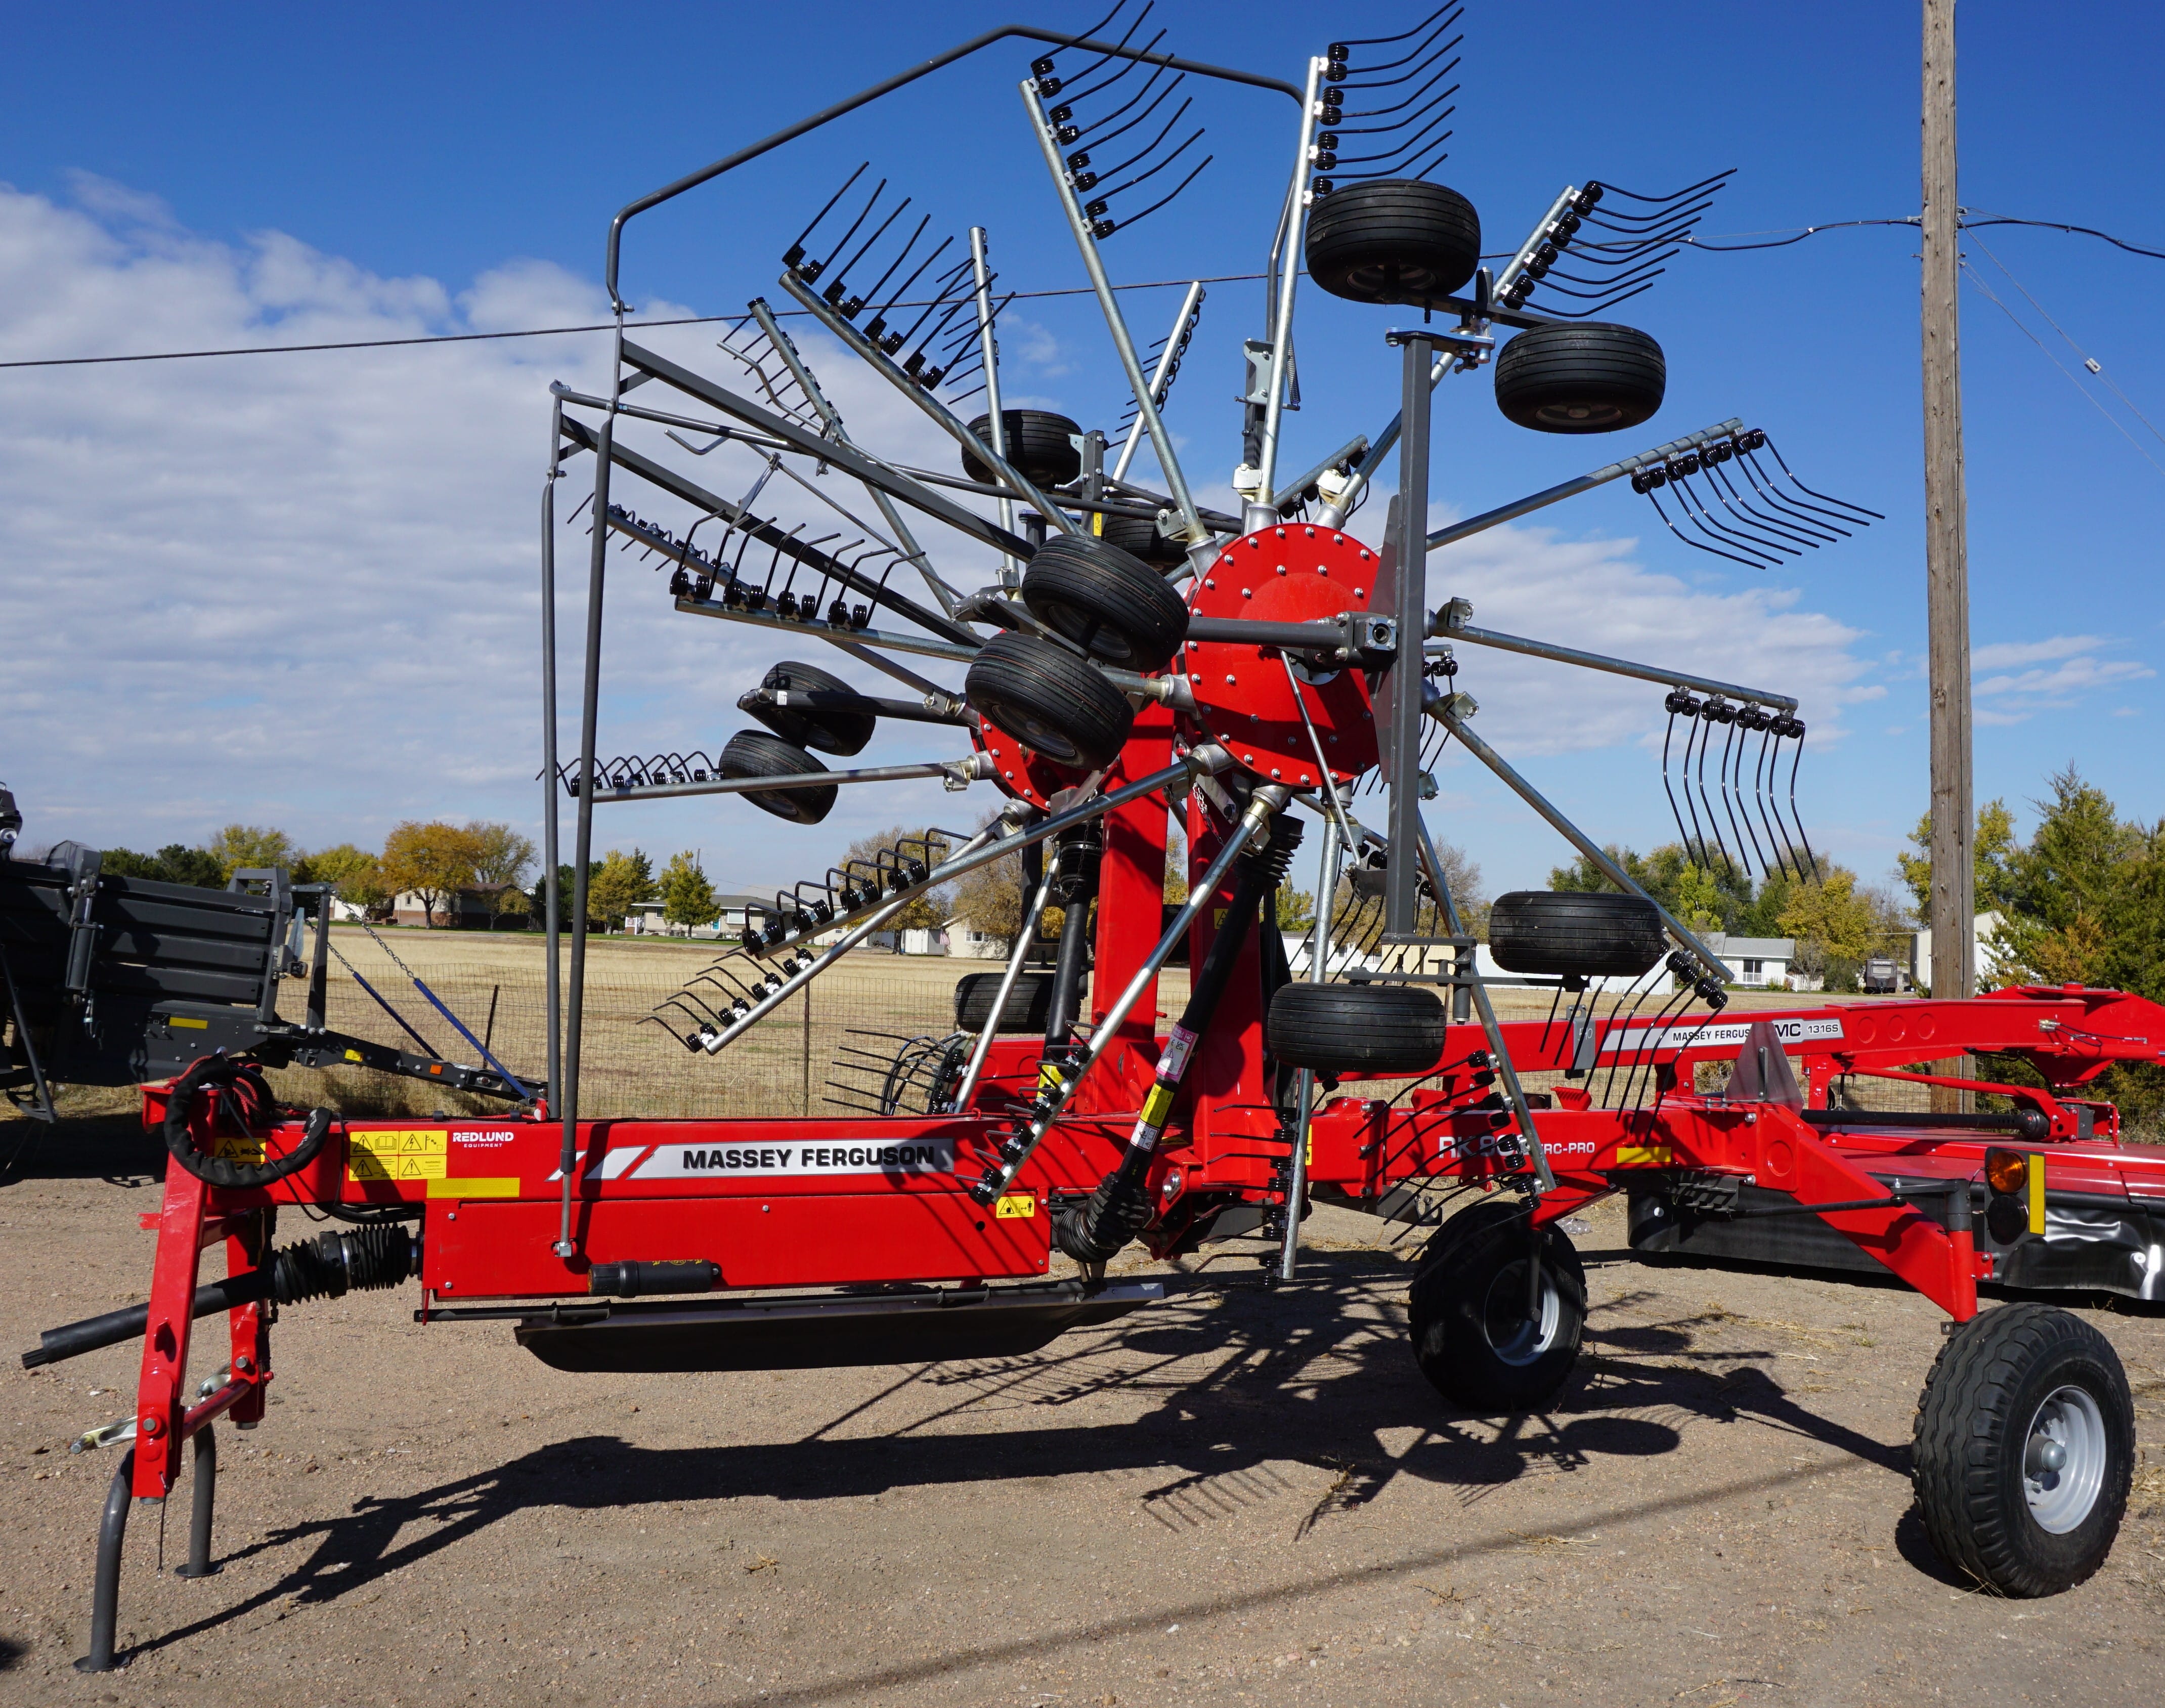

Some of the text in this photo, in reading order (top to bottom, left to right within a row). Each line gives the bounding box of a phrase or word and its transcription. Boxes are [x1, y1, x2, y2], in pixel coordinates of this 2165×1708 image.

[1672, 1023, 1838, 1042] MASSEY FERGUS MC 1316S
[453, 1132, 514, 1142] REDLUND
[1439, 1136, 1473, 1159] RK
[1541, 1141, 1595, 1155] RC-PRO
[683, 1146, 935, 1170] MASSEY FERGUSON
